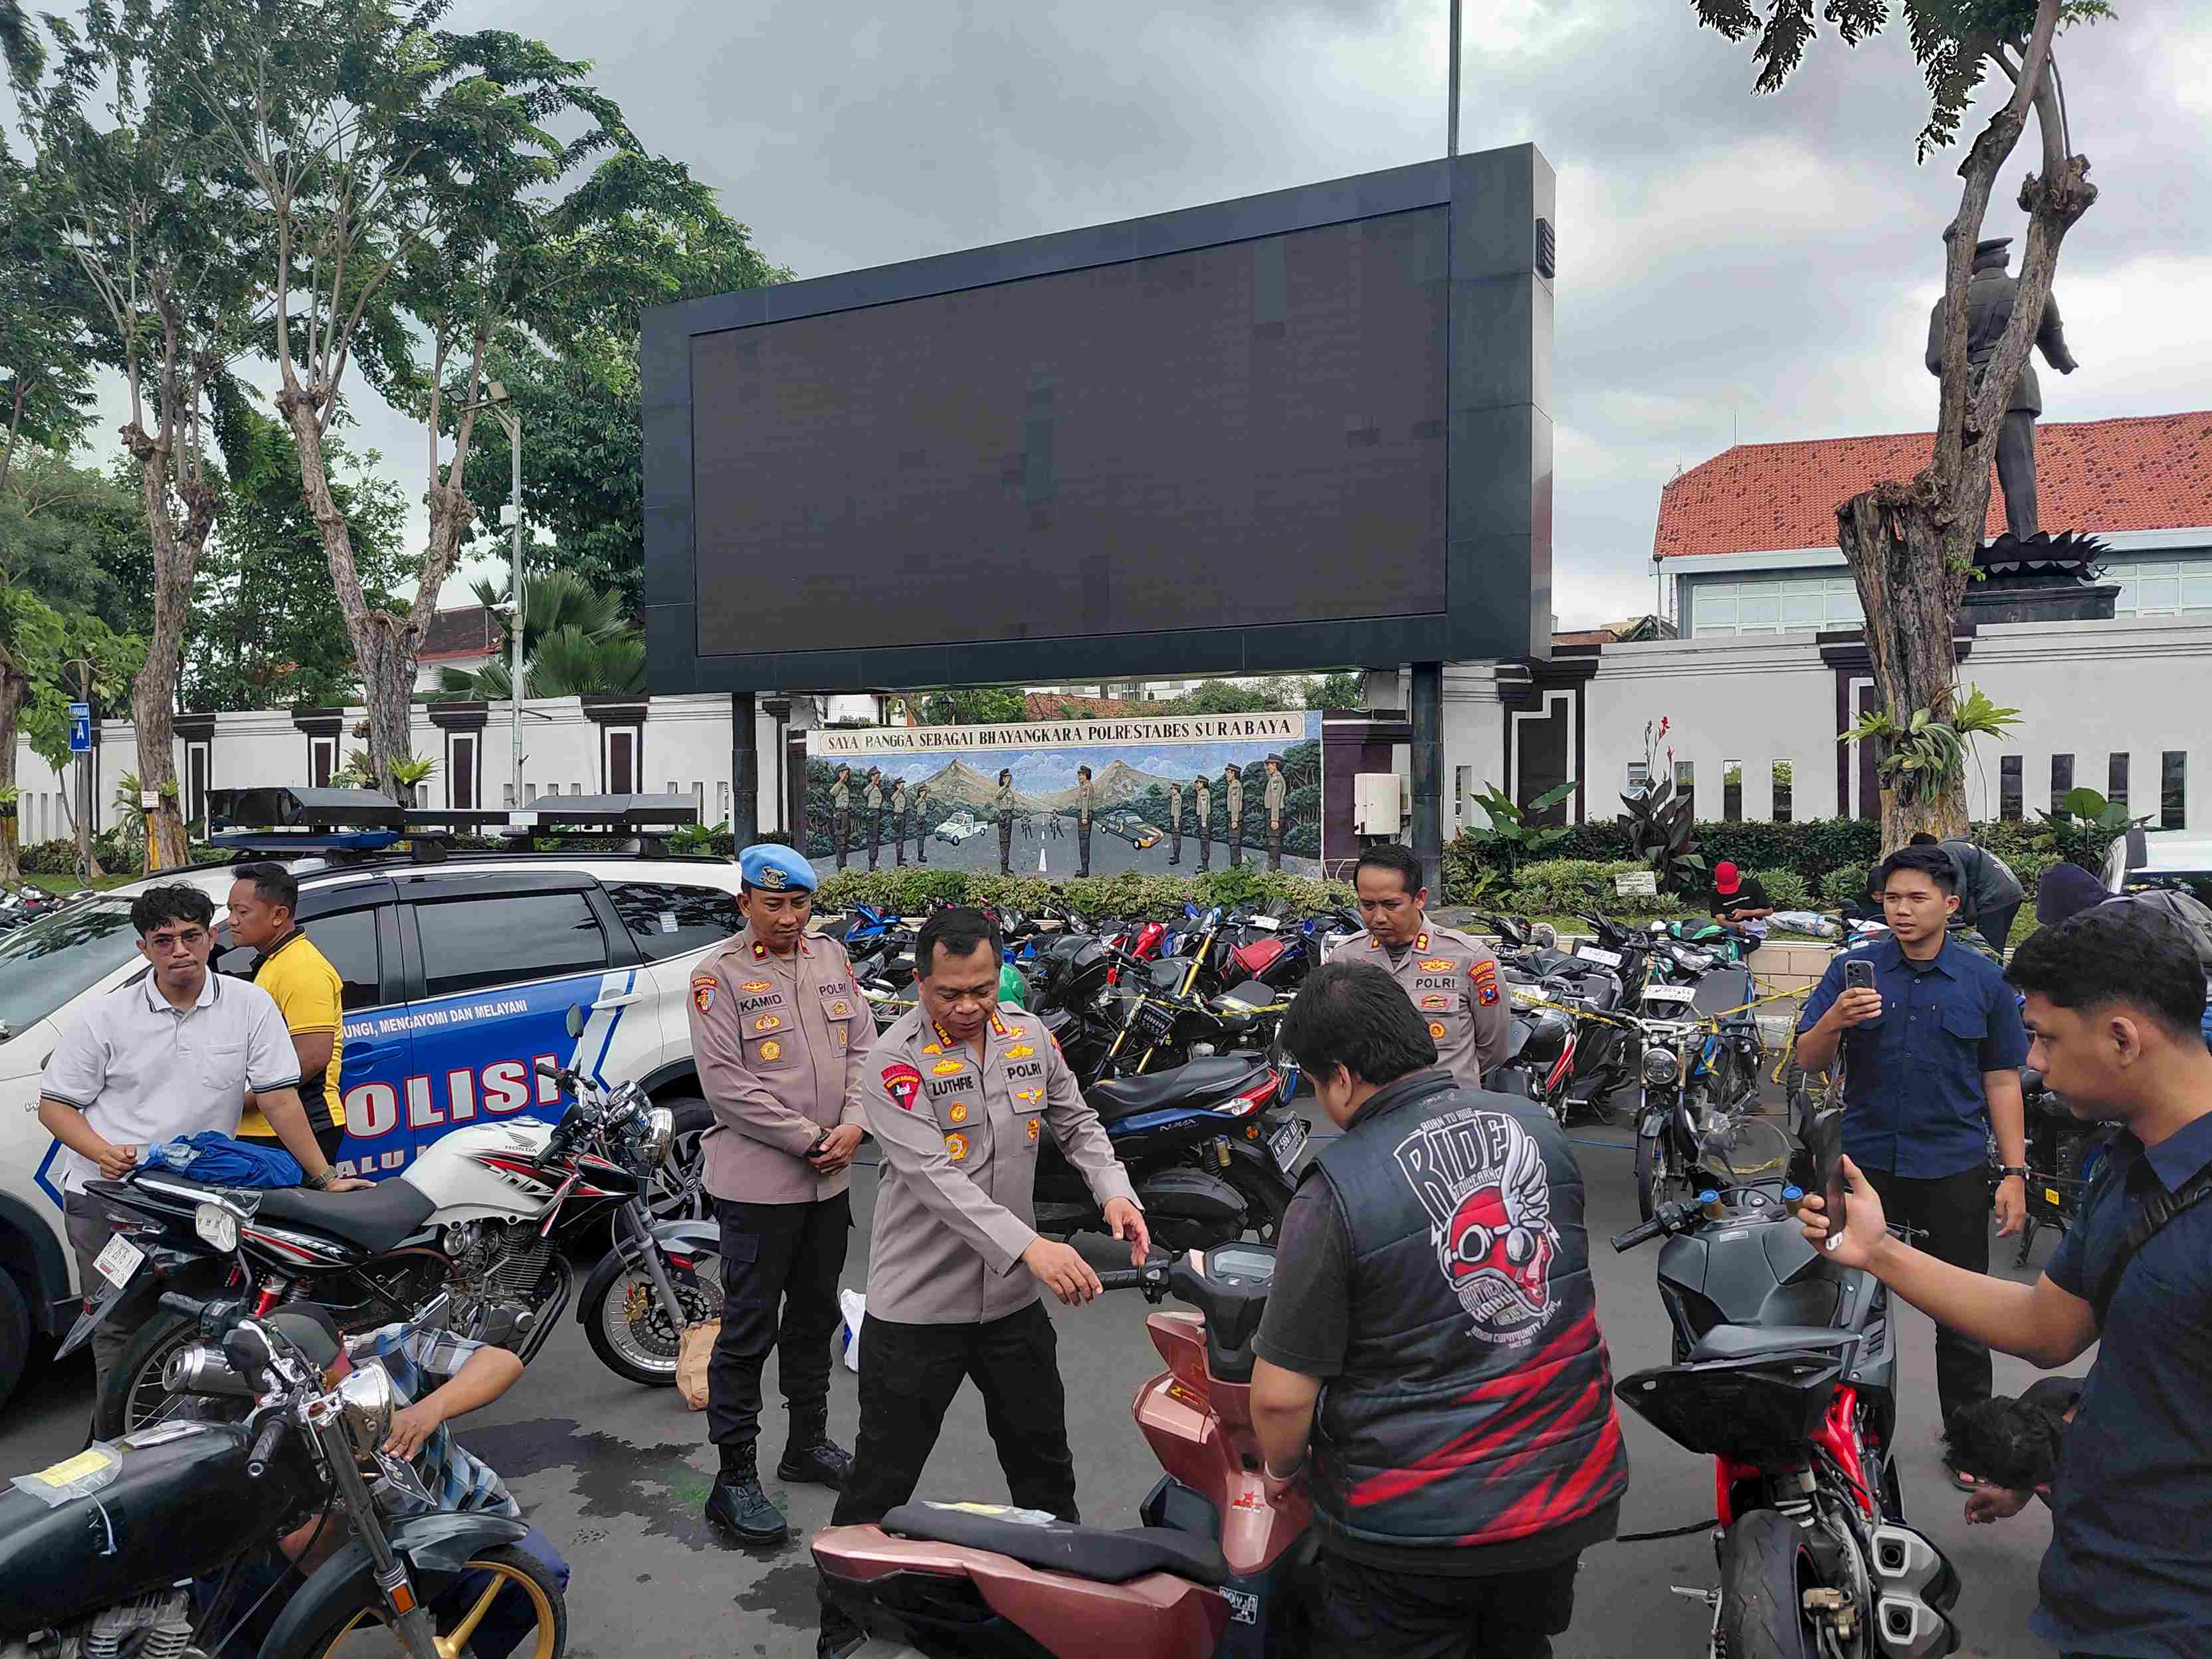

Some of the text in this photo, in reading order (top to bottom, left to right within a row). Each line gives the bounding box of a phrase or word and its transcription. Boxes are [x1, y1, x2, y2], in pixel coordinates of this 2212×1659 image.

[828, 735, 859, 750] SAYA
[919, 731, 973, 747] SEBAGAI
[979, 726, 1082, 745] BHAYANGKARA
[1088, 722, 1189, 741] POLRESTABES
[1195, 719, 1291, 737] SURABAYA
[819, 982, 847, 996] POLRI
[1415, 978, 1455, 989] POLRI
[739, 994, 782, 1013] KAMID
[342, 999, 528, 1039] UNGI, MENGAYOMI DAN MELAYANI
[1007, 1061, 1043, 1080] POLRI
[932, 1075, 975, 1096] LUTHFIE
[1419, 1107, 1475, 1131] BORN TO RIDE
[504, 1145, 538, 1153] HONDA
[1393, 1111, 1508, 1228] RIDE
